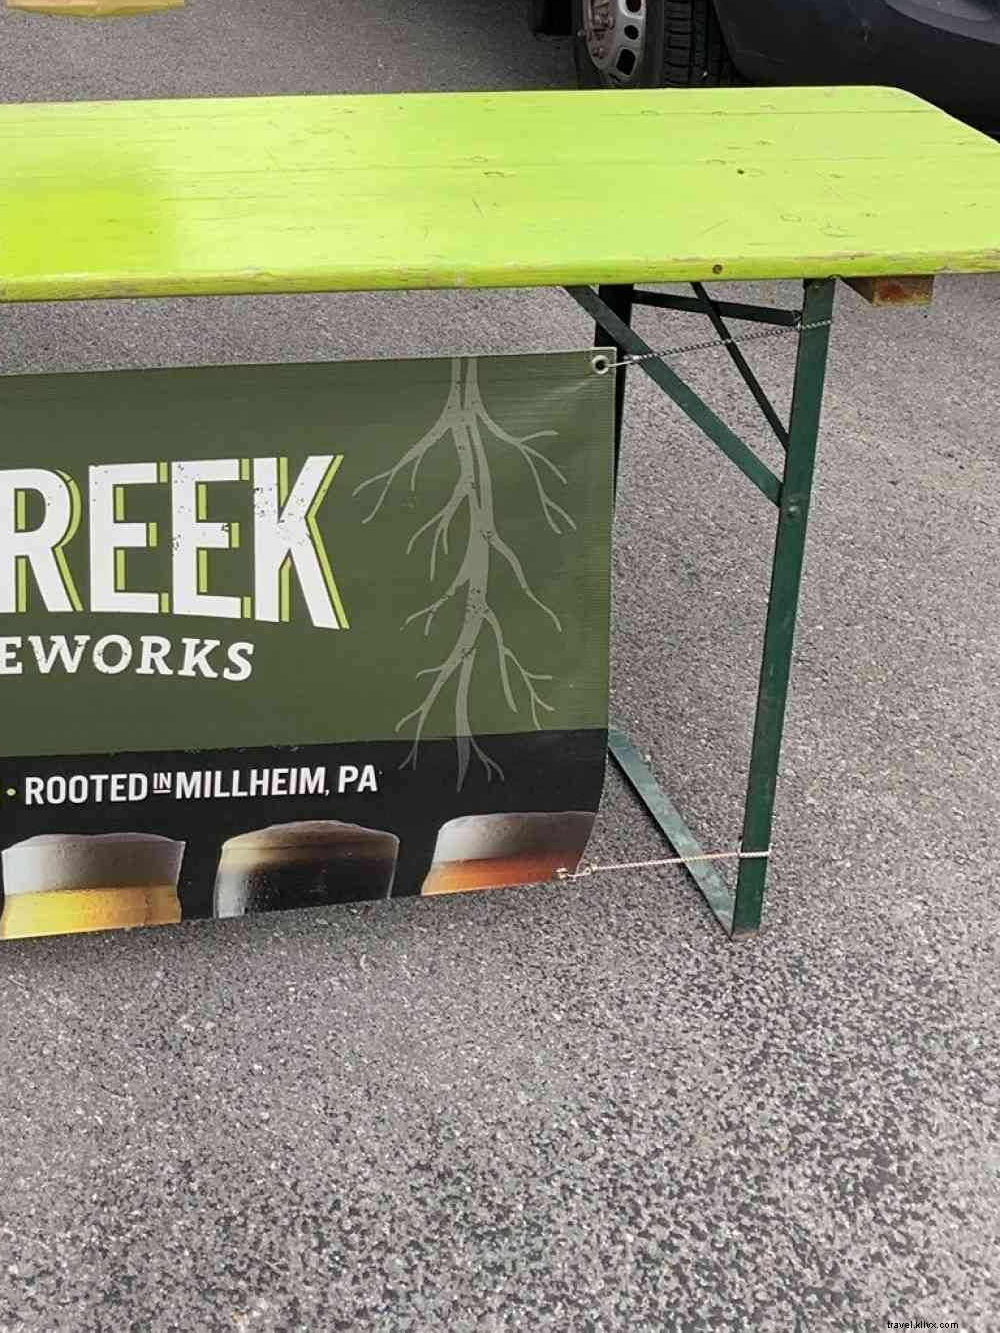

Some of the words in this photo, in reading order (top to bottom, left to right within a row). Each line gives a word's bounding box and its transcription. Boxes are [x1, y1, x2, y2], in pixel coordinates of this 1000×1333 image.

[24, 773, 149, 806] ROOTED
[152, 771, 171, 794] IN
[174, 766, 330, 799] MILLHEIM,
[337, 764, 379, 794] PA
